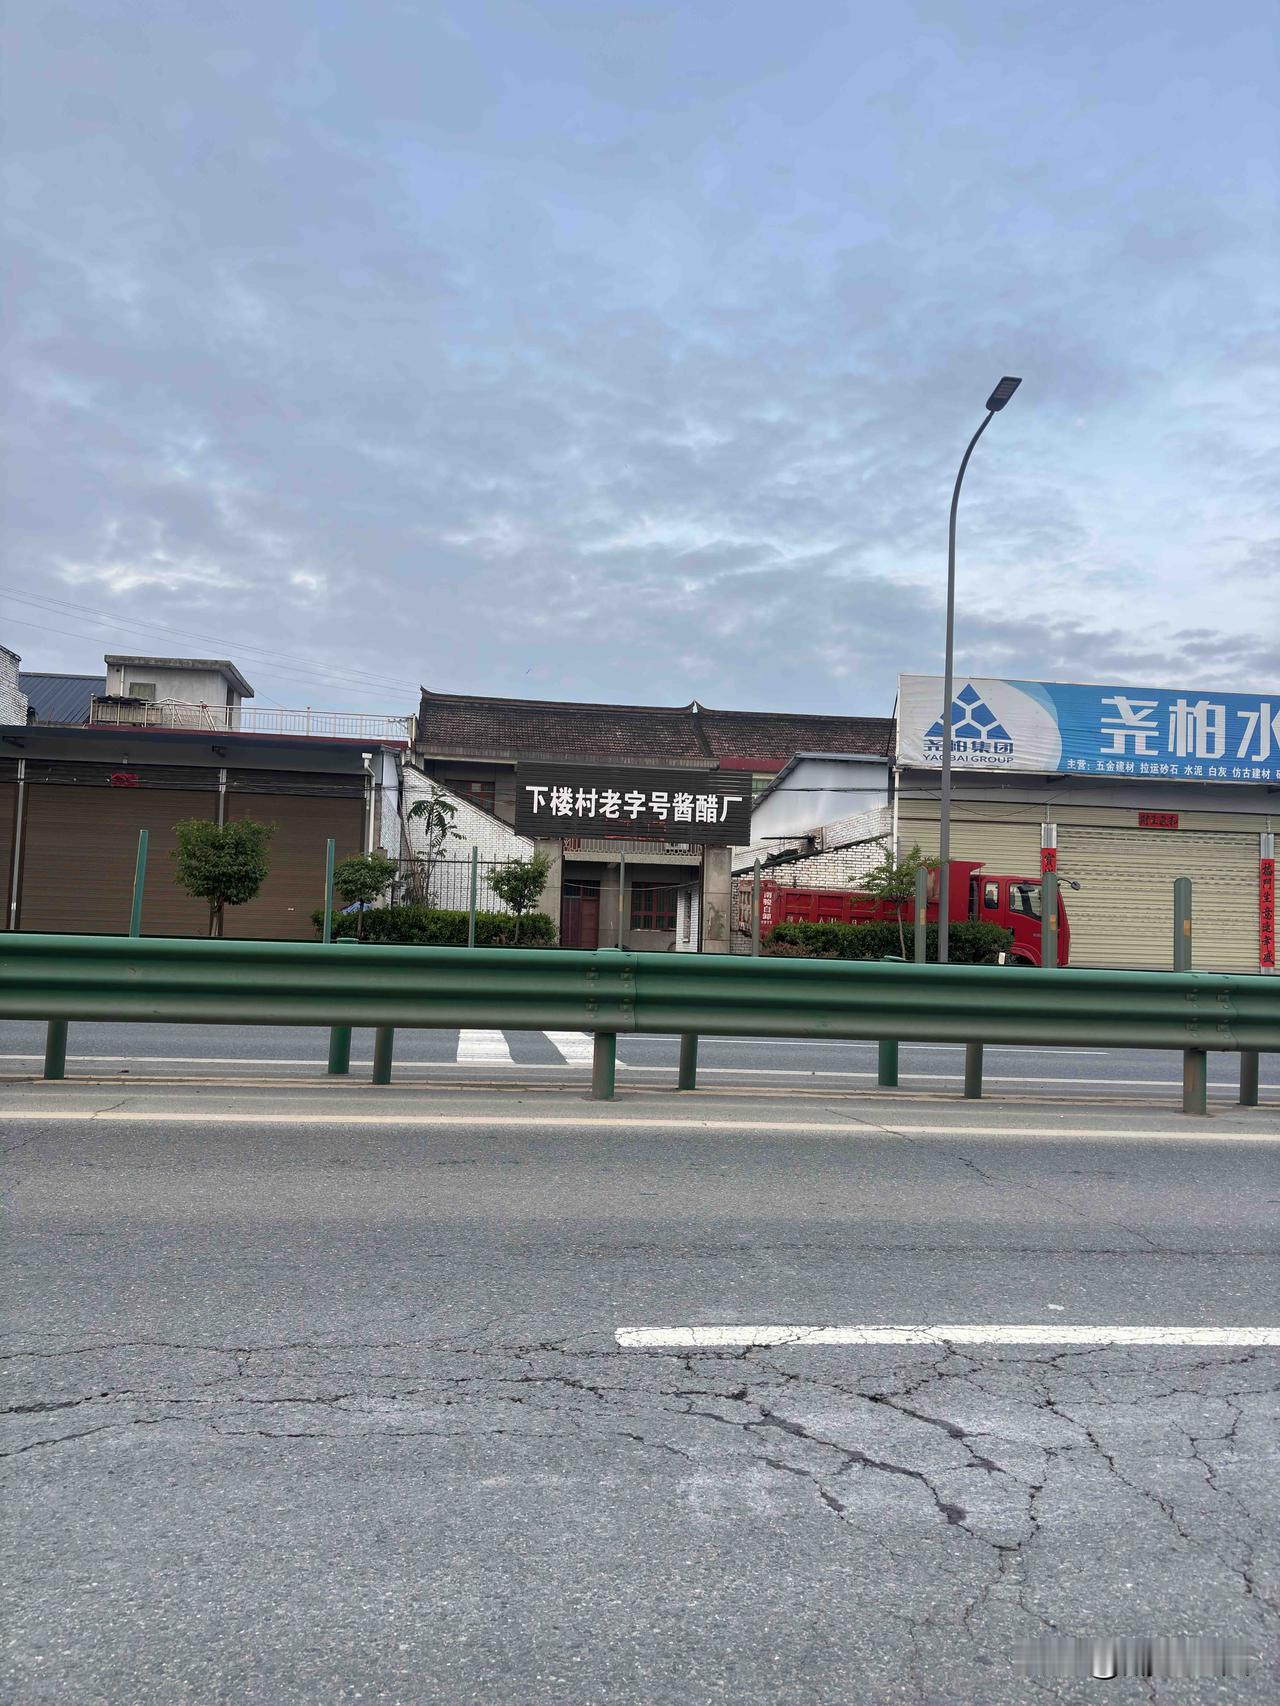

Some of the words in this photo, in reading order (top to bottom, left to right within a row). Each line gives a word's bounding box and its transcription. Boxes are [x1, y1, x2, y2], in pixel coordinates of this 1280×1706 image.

[1100, 695, 1280, 763] 尧柏水
[970, 755, 1014, 764] GROUP
[1095, 759, 1135, 774] 五金建材
[1140, 761, 1179, 776] 拉运砂石
[1184, 764, 1203, 777] 水泥
[1208, 765, 1227, 777] 白灰
[1232, 766, 1270, 780] 仿古建材
[525, 785, 743, 824] 下楼村老字号酱醋厂
